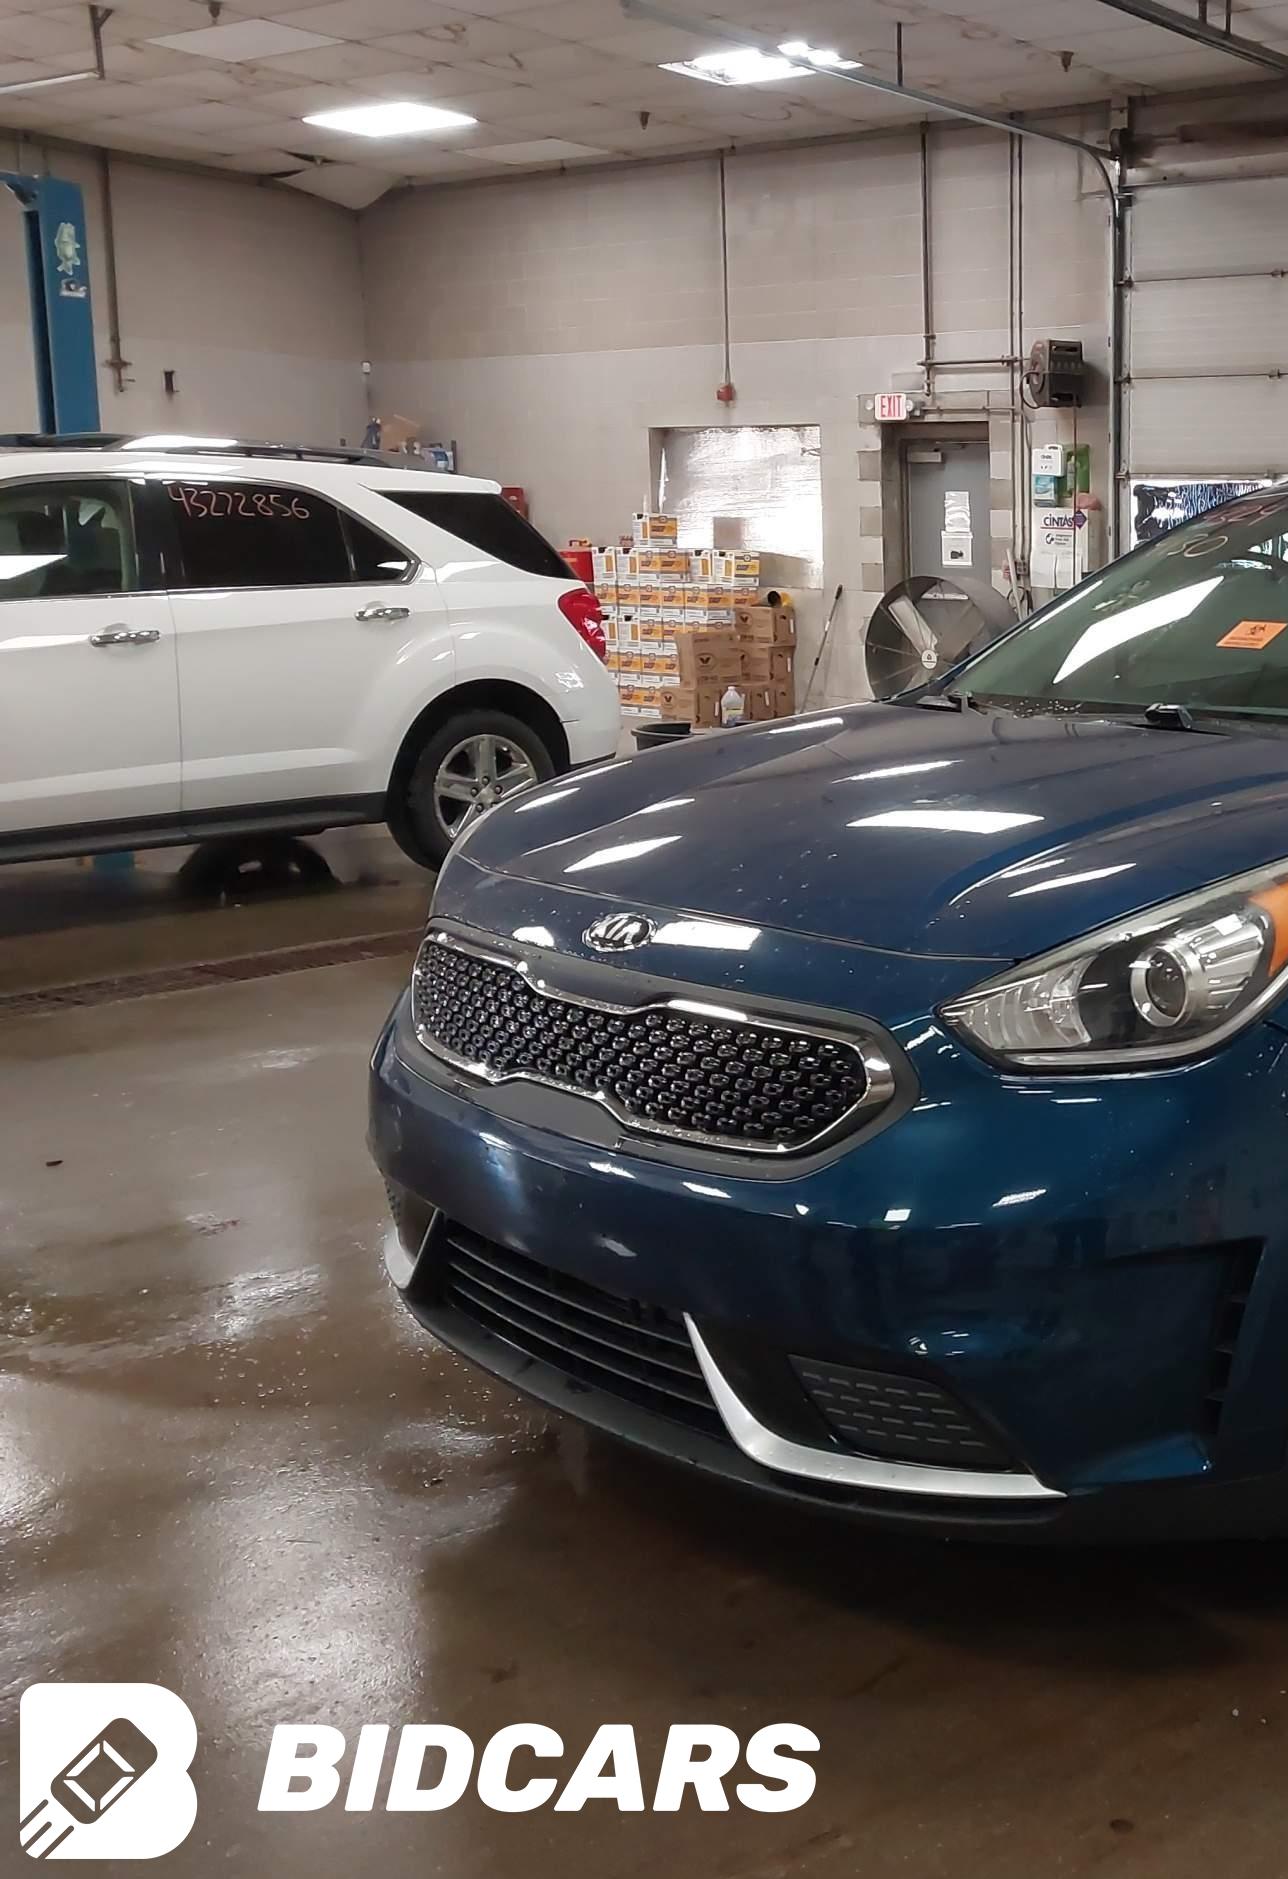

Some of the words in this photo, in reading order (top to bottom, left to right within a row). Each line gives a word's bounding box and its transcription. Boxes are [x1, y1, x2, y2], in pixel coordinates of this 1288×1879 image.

[880, 395, 902, 417] EXIT
[168, 486, 310, 519] 43272856
[1043, 513, 1073, 527] CINTAS
[590, 917, 643, 945] KIA
